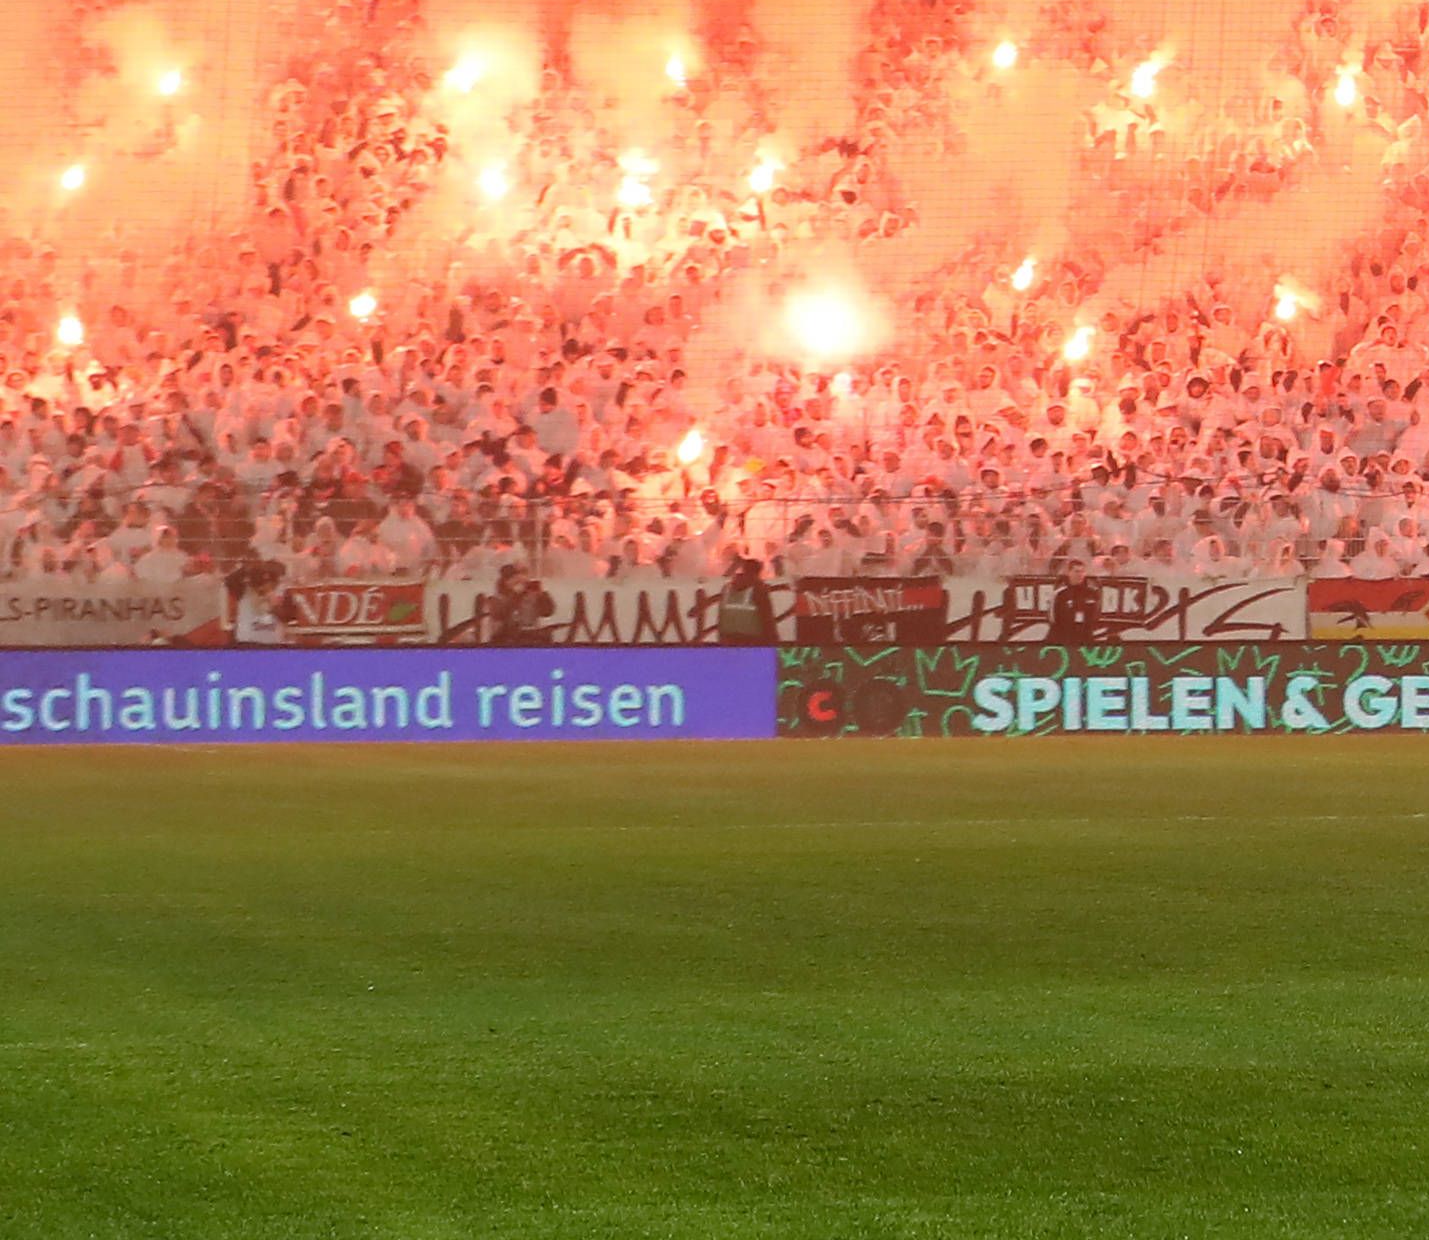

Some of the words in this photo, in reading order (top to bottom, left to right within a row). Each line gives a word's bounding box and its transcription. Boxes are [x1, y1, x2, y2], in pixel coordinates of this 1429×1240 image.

[2, 670, 454, 732] schauinsland
[476, 669, 685, 729] reisen
[972, 675, 1266, 731] SPIELEN
[1281, 675, 1330, 731] &
